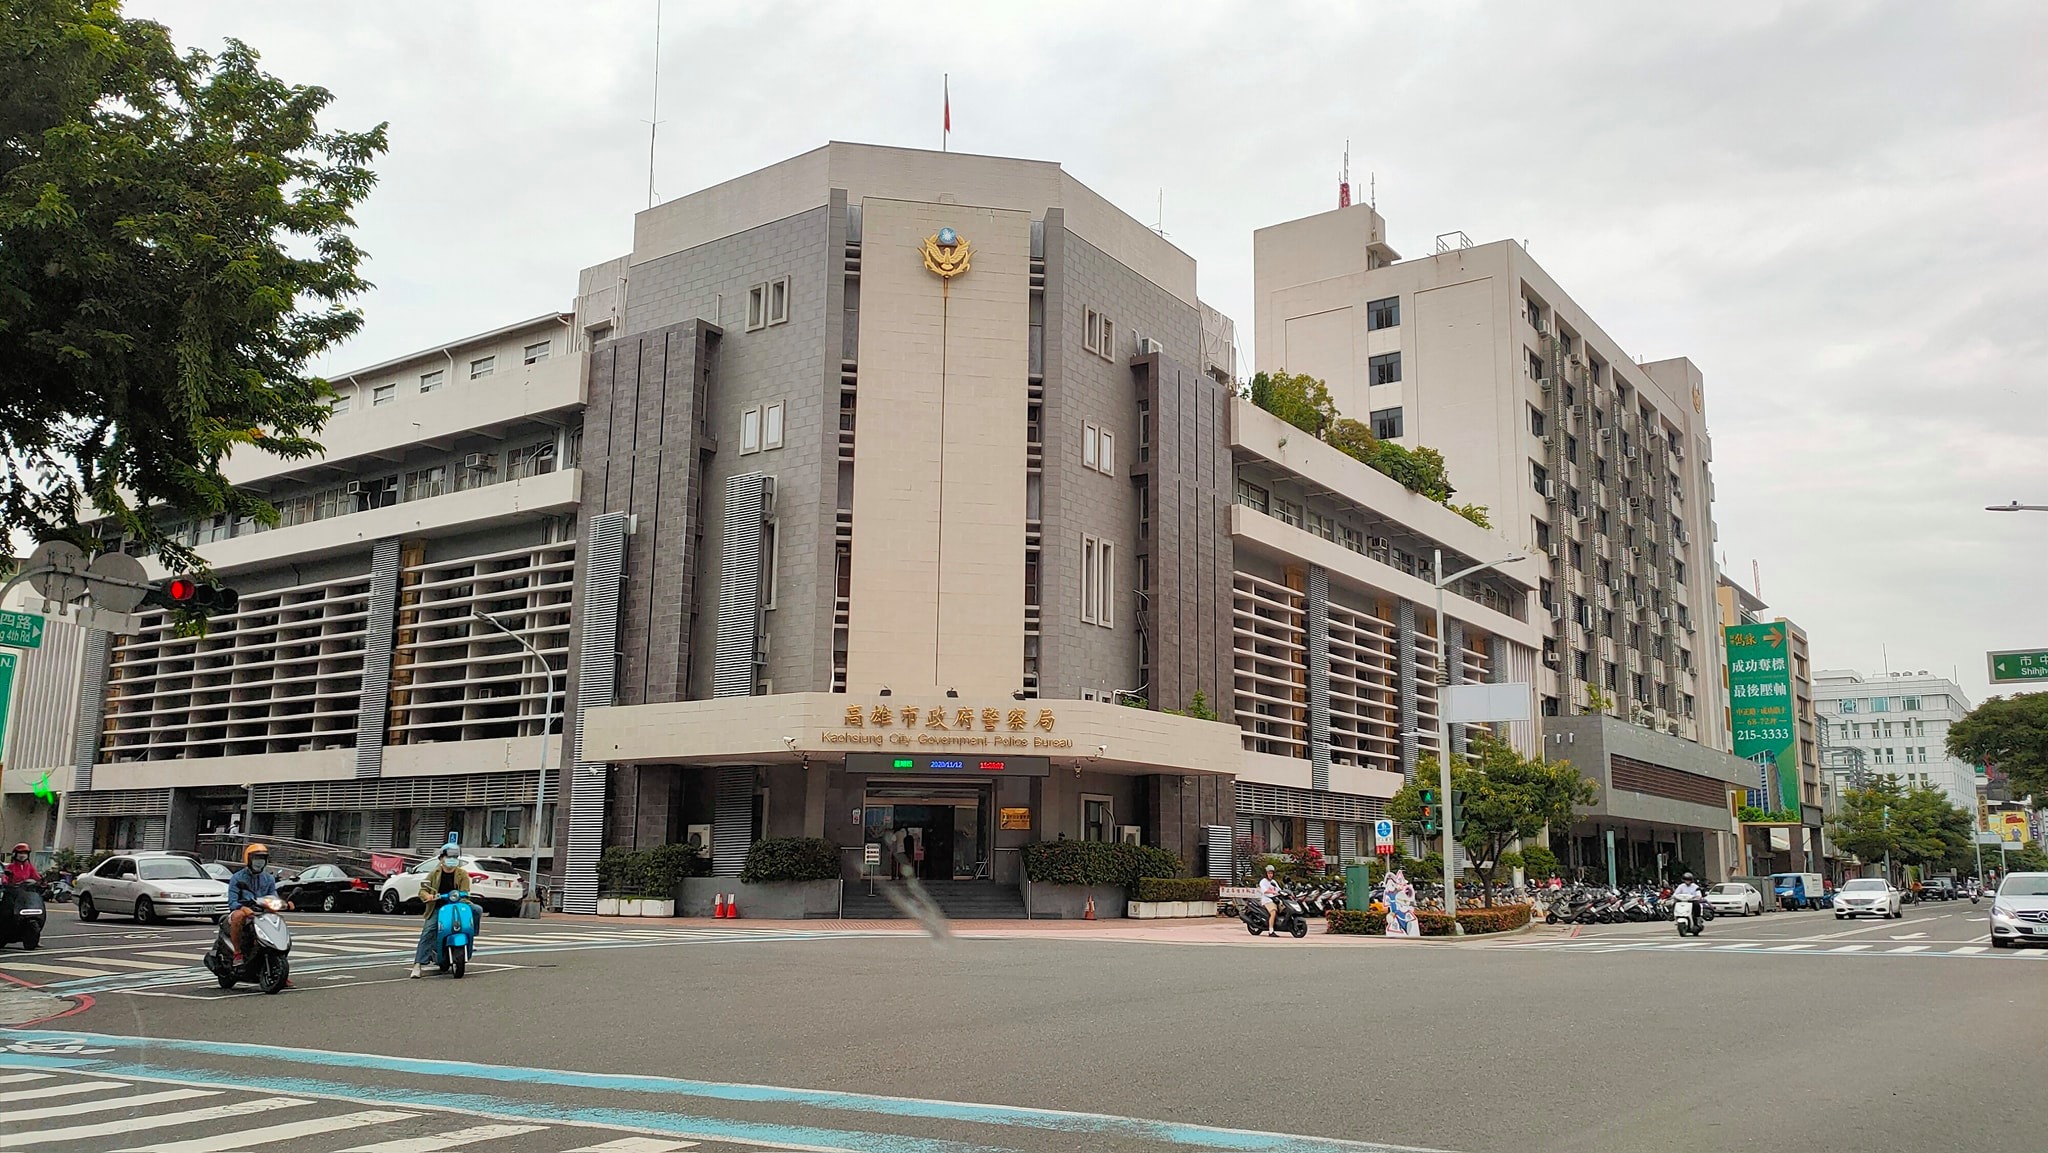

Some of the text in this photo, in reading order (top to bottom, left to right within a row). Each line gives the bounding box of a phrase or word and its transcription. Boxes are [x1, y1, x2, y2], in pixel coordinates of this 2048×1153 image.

[0, 613, 32, 630] 四路
[6, 630, 19, 641] 4th
[20, 630, 30, 643] Rd
[1732, 658, 1786, 673] 成功奪標
[1734, 682, 1786, 698] 最後壓軸
[844, 703, 1056, 733] 高雄市政府警察局
[821, 730, 1073, 748] Kaohsiung City Government Police Bureau
[1737, 728, 1789, 740] 215-3333
